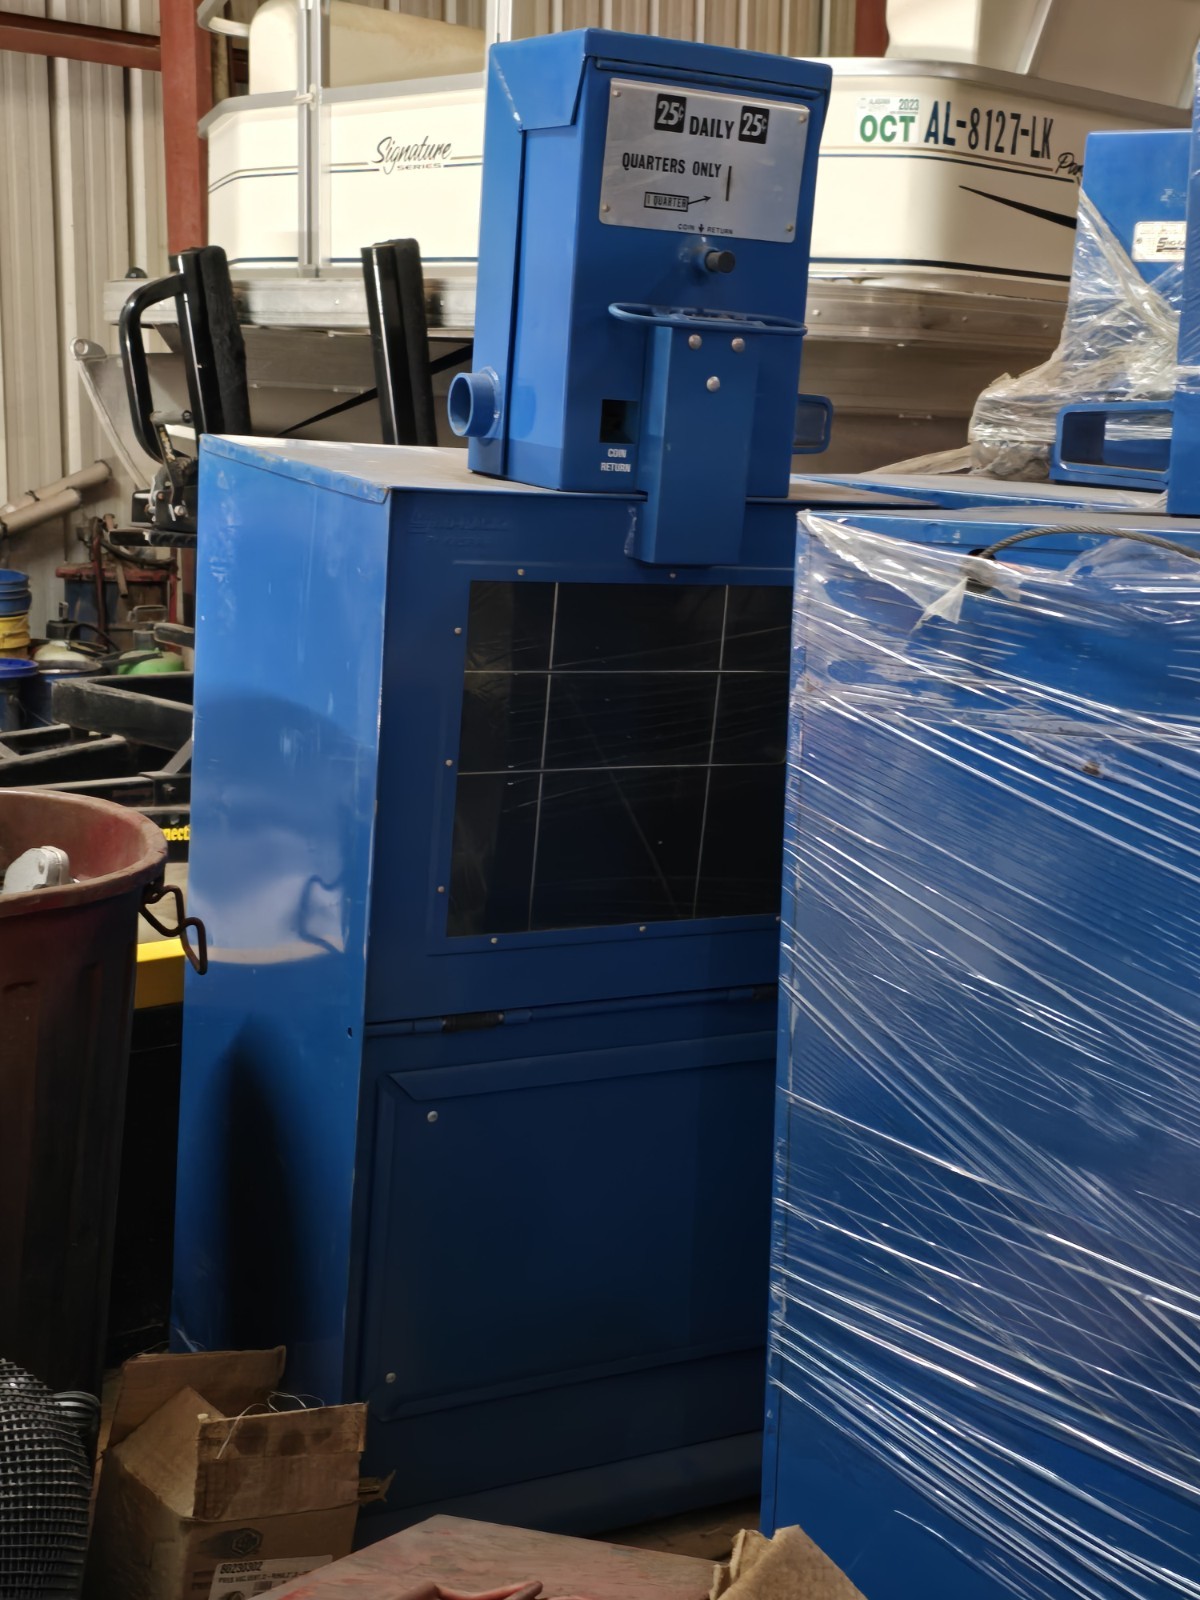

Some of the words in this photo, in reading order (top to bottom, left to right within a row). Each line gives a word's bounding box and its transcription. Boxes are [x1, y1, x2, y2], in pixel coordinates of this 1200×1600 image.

[899, 99, 919, 111] 2023
[689, 116, 735, 139] DAILY
[860, 114, 916, 142] OCT
[924, 100, 1054, 159] AL-8127-LK
[371, 135, 452, 175] Signature
[397, 163, 442, 171] SERIES
[622, 152, 686, 174] QUARTERS
[692, 160, 722, 178] ONLY
[652, 194, 687, 208] QUARTER
[677, 223, 695, 231] COIN
[706, 227, 734, 235] RETURN
[607, 448, 627, 458] COIN
[600, 462, 632, 473] RETURN
